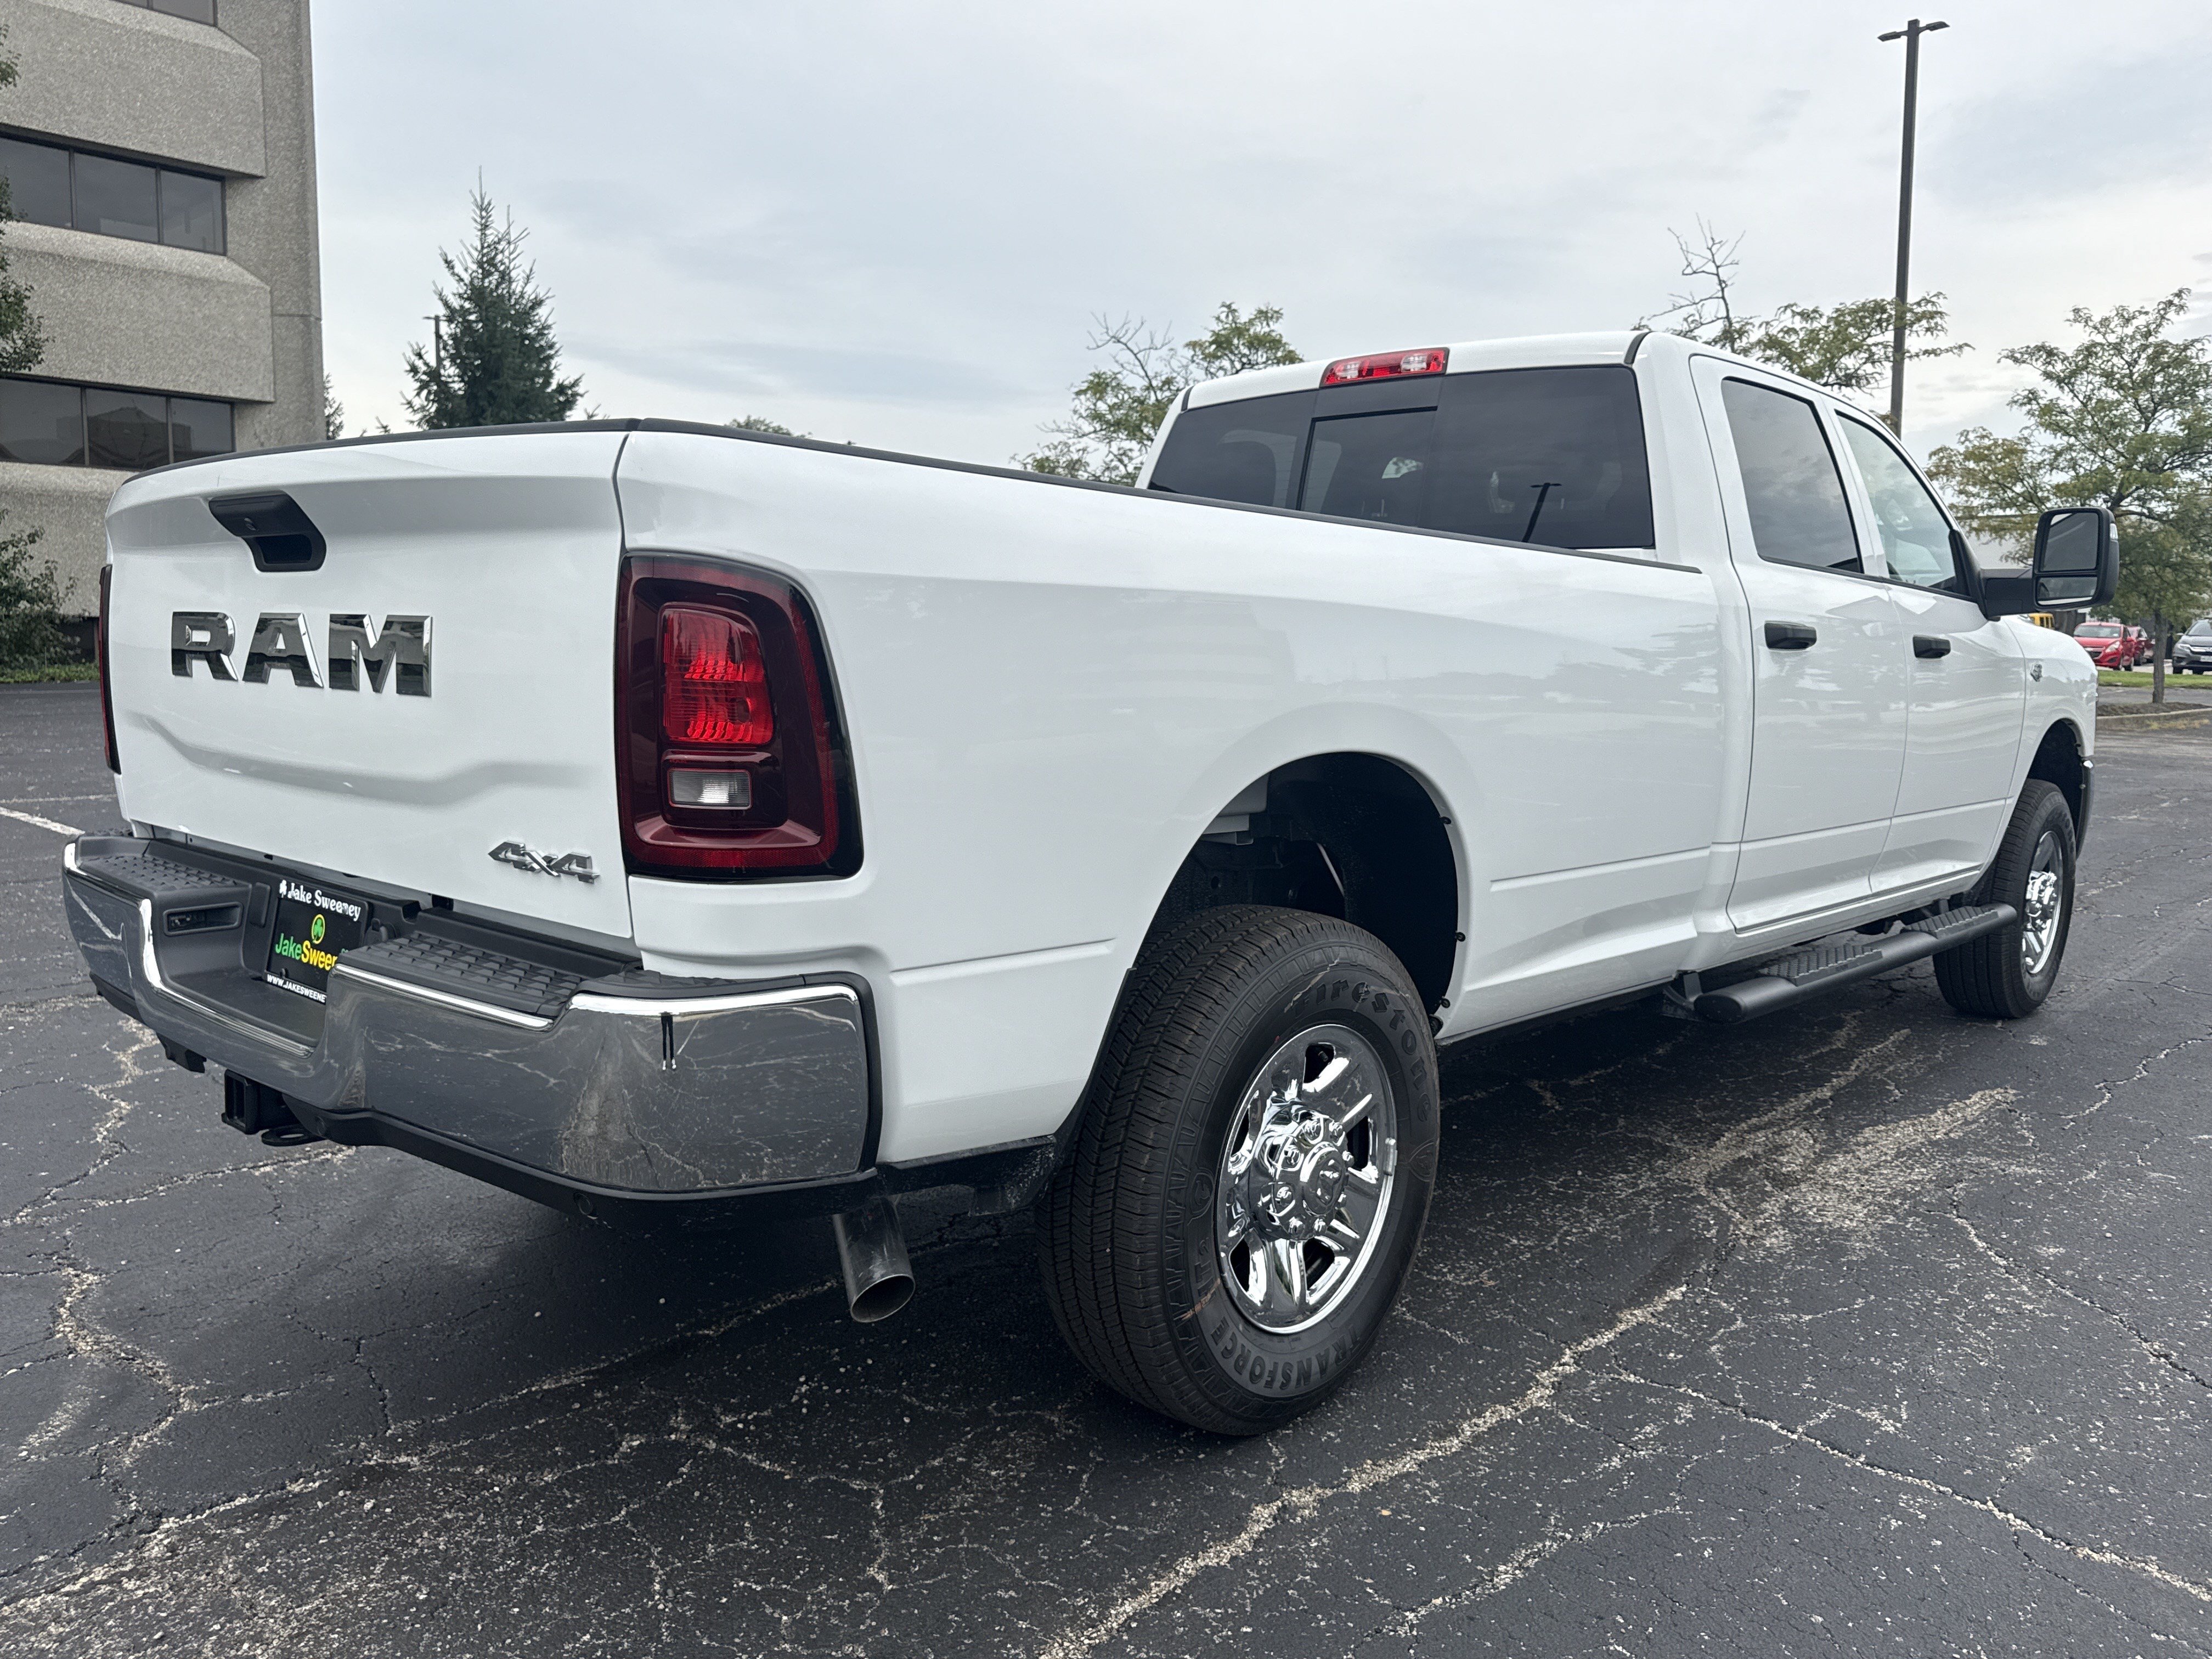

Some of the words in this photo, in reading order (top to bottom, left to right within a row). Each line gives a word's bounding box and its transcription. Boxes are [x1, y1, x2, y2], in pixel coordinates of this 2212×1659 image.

[172, 611, 432, 697] RAM
[287, 882, 312, 904] Jake
[314, 889, 361, 922] Sweeney
[267, 973, 327, 1003] WWW.JAKESWEENE
[1210, 1317, 1361, 1391] TRANSFORCE
